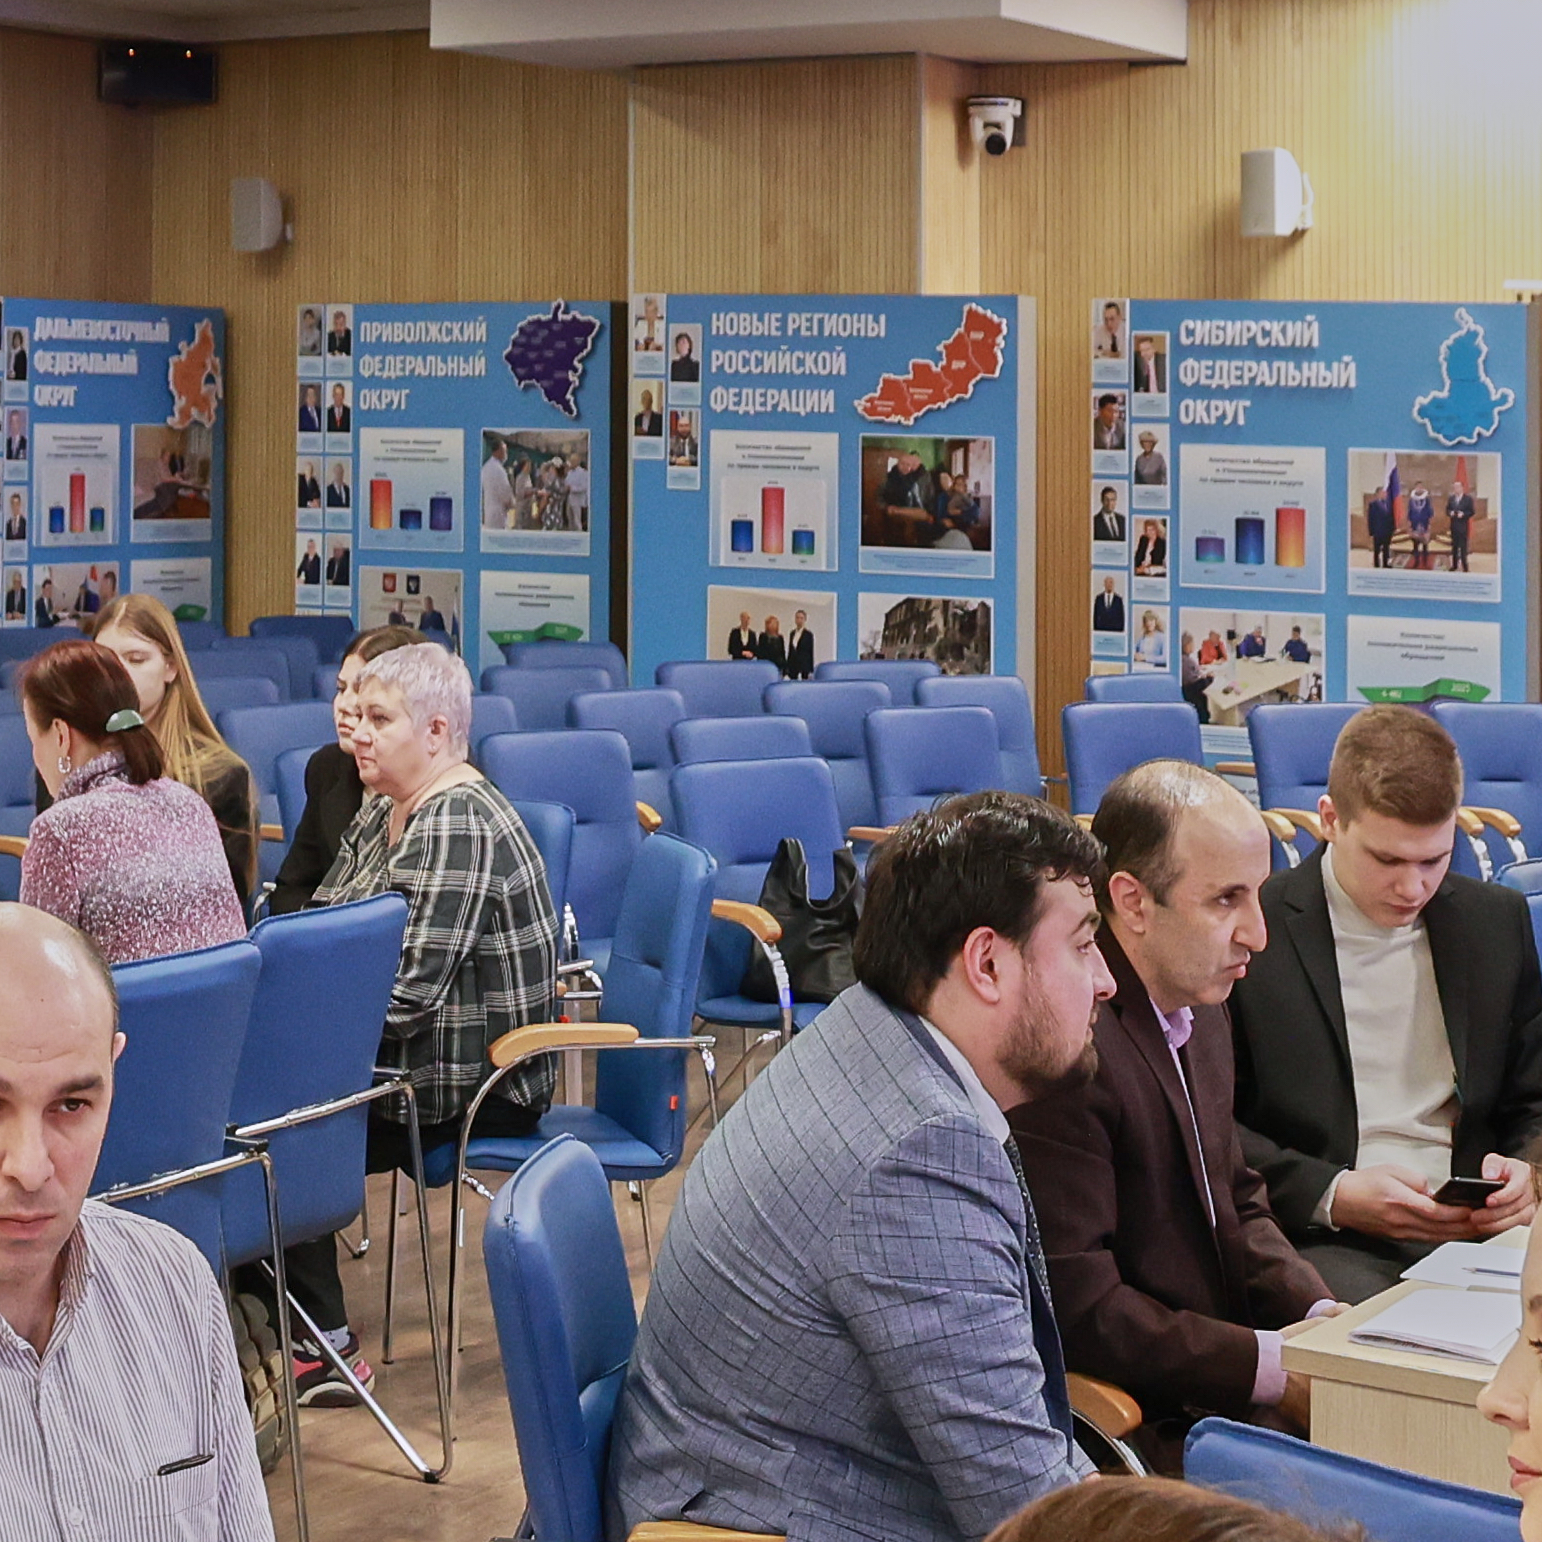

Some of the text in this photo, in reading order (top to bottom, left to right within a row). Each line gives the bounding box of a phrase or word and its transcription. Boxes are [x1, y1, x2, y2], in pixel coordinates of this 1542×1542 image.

[360, 315, 487, 344] ПРИВОЛЖСКИЙ
[711, 312, 886, 339] НОВЫЕ РЕГИОНЫ
[1179, 314, 1320, 348] СИБИРСКИЙ
[359, 349, 486, 379] ФЕДЕРАЛЬНЫЙ
[710, 345, 847, 377] РОССИЙСКОЙ
[1178, 354, 1357, 390] ФЕДЕРАЛЬНЫЙ
[359, 388, 410, 411] ОКРУГ
[709, 385, 835, 416] ФЕДЕРАЦИИ
[1179, 398, 1251, 427] ОКРУГ
